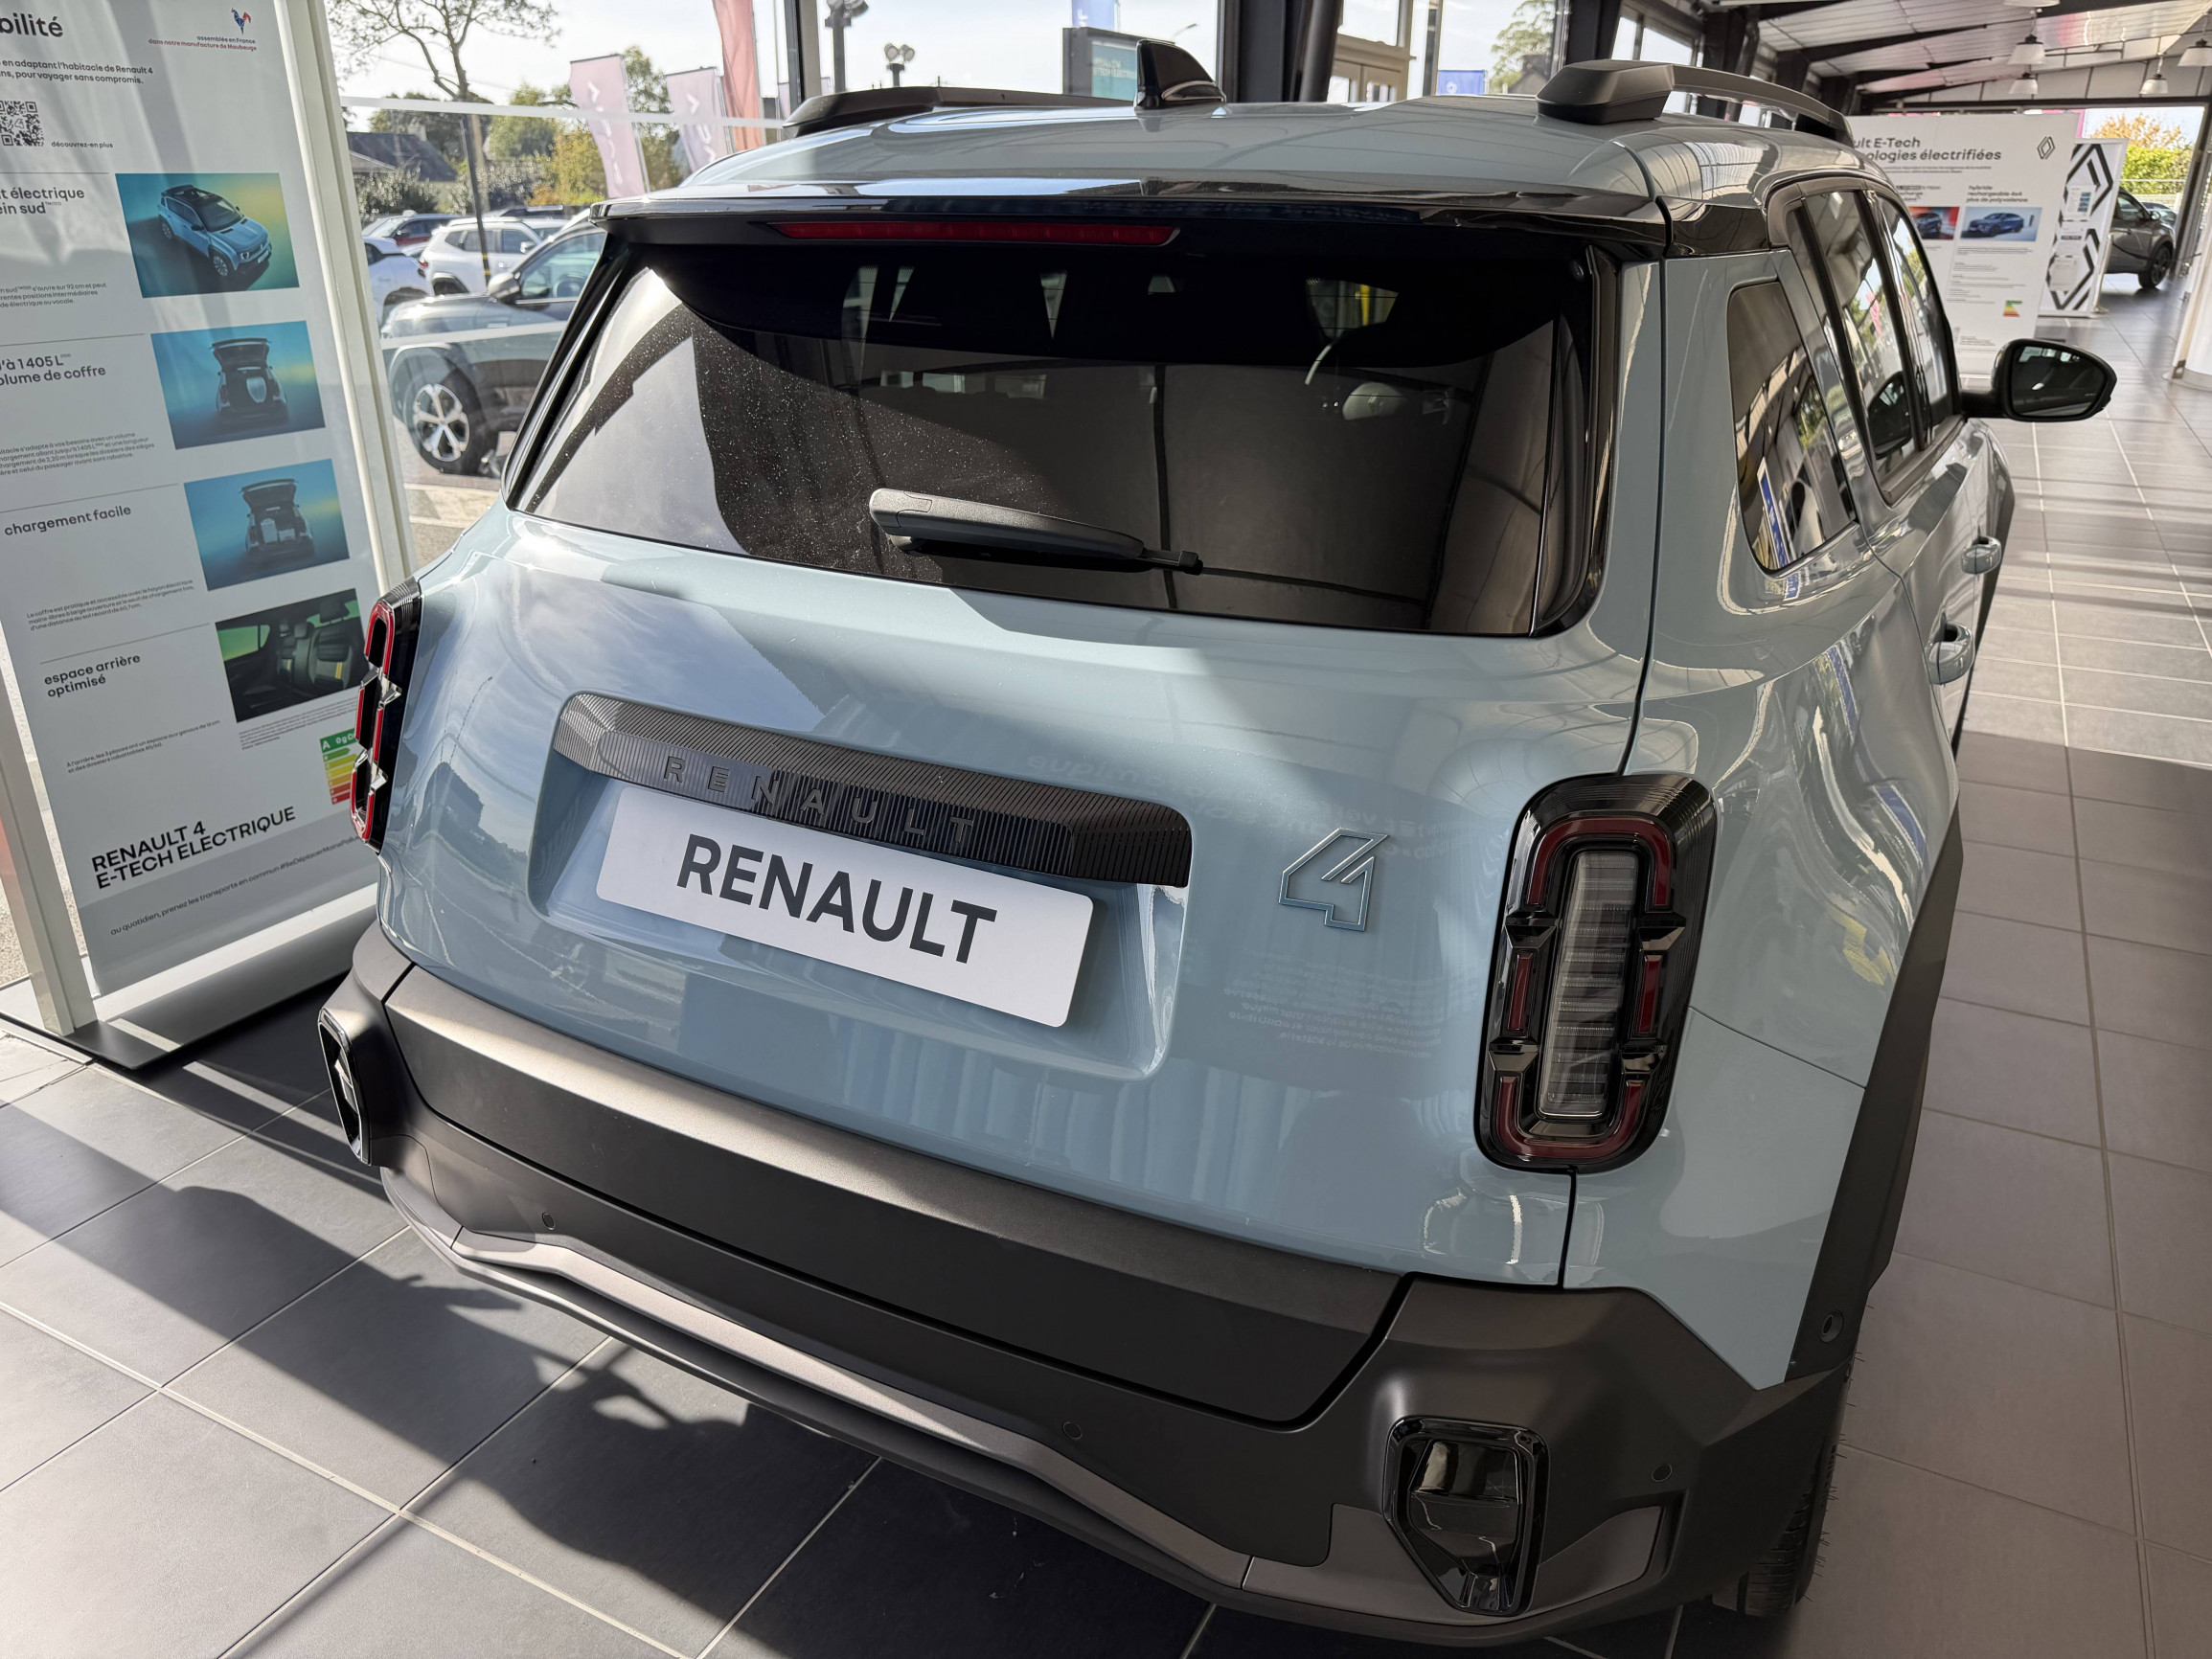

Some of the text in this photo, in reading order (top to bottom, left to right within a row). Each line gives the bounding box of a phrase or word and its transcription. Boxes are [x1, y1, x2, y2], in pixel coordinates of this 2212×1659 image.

[14, 58, 57, 70] adaptant
[104, 63, 115, 72] de
[116, 65, 147, 74] Renault
[15, 71, 35, 80] pour
[36, 73, 73, 81] voyager
[95, 75, 144, 84] compromis.
[1874, 136, 1920, 148] E-Tech
[1920, 148, 2001, 161] électrifiées
[11, 187, 84, 202] électrique
[19, 202, 46, 214] sud
[55, 355, 63, 366] L
[44, 370, 61, 381] de
[64, 366, 105, 379] coffre
[4, 506, 131, 535] chargement facile
[44, 654, 141, 684] espace arrière
[47, 673, 106, 697] optimisé
[322, 739, 331, 750] A
[663, 756, 973, 843] RENAULT
[91, 821, 206, 873] RENAULT 4
[96, 806, 297, 890] E-TECH ELECTRIQUE
[1278, 827, 1389, 931] 4
[110, 925, 122, 936] au
[122, 911, 162, 931] quotidien,
[161, 901, 188, 917] prenez
[199, 882, 239, 901] transports
[248, 867, 279, 882] commun
[676, 833, 997, 965] RENAULT
